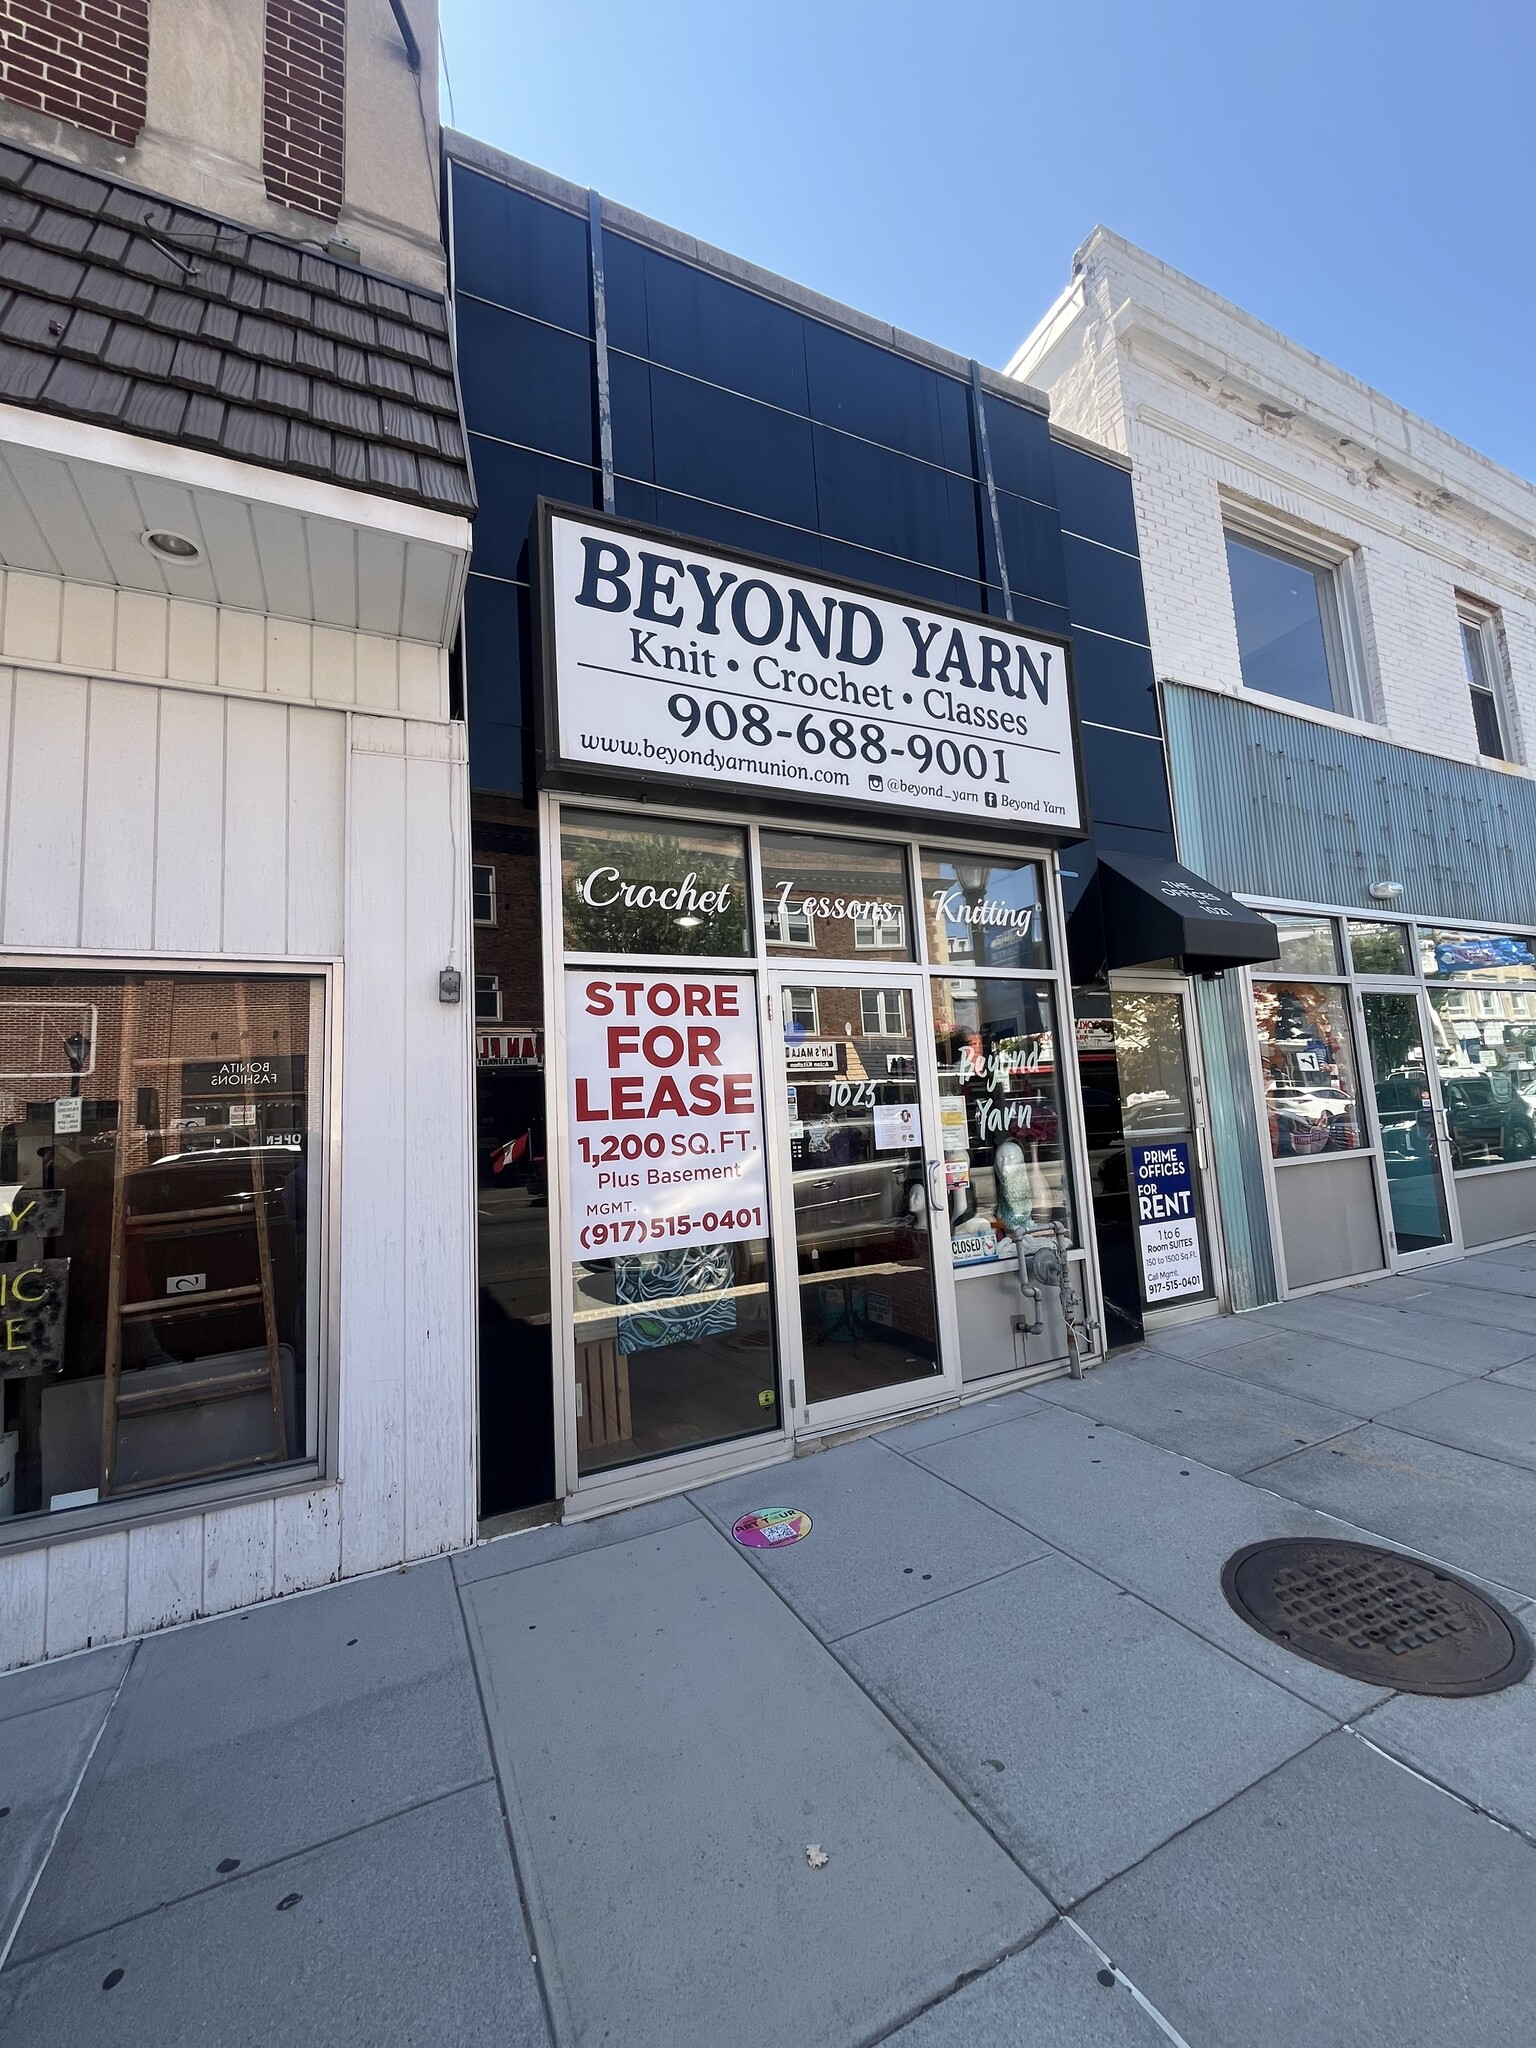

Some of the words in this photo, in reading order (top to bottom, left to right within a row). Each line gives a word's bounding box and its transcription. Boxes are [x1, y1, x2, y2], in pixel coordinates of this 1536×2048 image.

[574, 536, 884, 666] BEYOND
[902, 616, 1052, 705] YARN
[629, 628, 717, 678] Knit
[753, 655, 894, 710] Crochet
[923, 688, 1028, 735] Classes
[667, 693, 1010, 784] 908-688-9001
[580, 733, 850, 786] www.beyondyarnunion.com
[887, 778, 979, 803] @beyond_yarn
[1001, 794, 1040, 812] Beyond
[1043, 800, 1066, 815] Yarn
[1161, 880, 1194, 891] THE
[1161, 888, 1221, 901] OFFICES
[583, 866, 731, 913] Crochet
[775, 881, 899, 922] Lessons
[932, 890, 1032, 937] Knitting
[1199, 905, 1233, 916] 1021
[585, 981, 740, 1017] STORE
[607, 1025, 723, 1069] FOR
[958, 1041, 1040, 1092] Beyond
[575, 1073, 755, 1122] LEASE
[976, 1098, 1031, 1140] Yarn
[577, 1132, 666, 1168] 1,200
[1143, 1148, 1178, 1164] PRIME
[598, 1171, 640, 1189] Plus
[647, 1162, 742, 1185] Basement
[1139, 1161, 1186, 1179] OFFICES
[1138, 1184, 1158, 1196] FOR
[586, 1201, 637, 1217] MGMT.
[1139, 1190, 1191, 1220] RENT
[1158, 1230, 1162, 1240] 1
[1164, 1229, 1174, 1240] to
[1174, 1228, 1181, 1238] 6
[952, 1238, 981, 1255] CLOSED
[1147, 1242, 1169, 1253] Room
[1169, 1238, 1193, 1250] SUITES
[1146, 1257, 1157, 1267] 150
[1157, 1256, 1164, 1265] to
[1165, 1253, 1180, 1264] 1500
[1147, 1272, 1159, 1282] Call
[1148, 1275, 1200, 1295] 917-515-0401
[735, 1521, 759, 1532] ART
[762, 1510, 797, 1523] TUR
